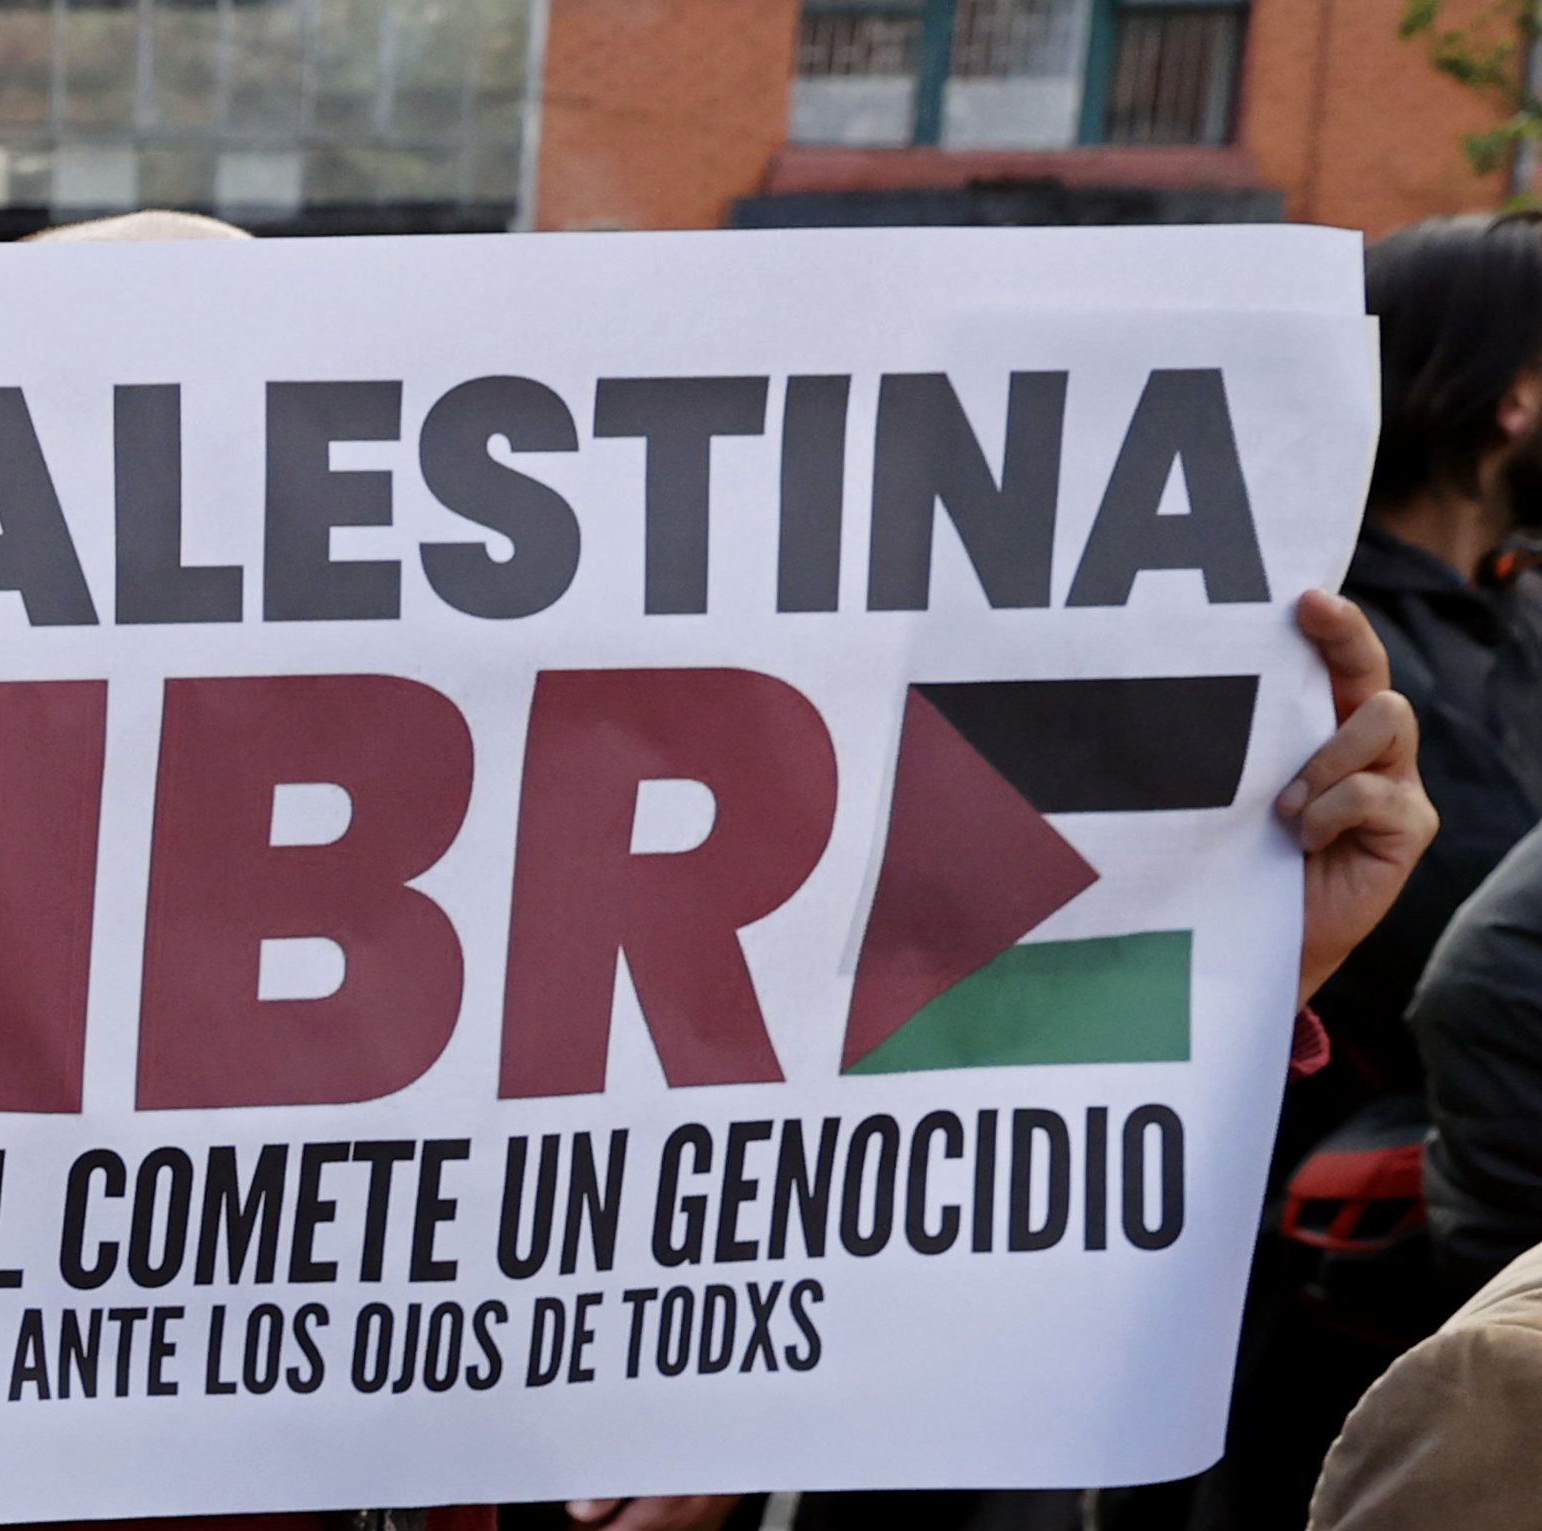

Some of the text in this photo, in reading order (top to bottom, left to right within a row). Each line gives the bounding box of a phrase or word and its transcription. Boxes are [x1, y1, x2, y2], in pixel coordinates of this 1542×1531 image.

[59, 1137, 472, 1291] COMETE
[496, 1128, 630, 1281] UN
[650, 1103, 1186, 1268] GENOCIDIO
[7, 1278, 825, 1402] ANTE LOS OJOS DE TODXS
